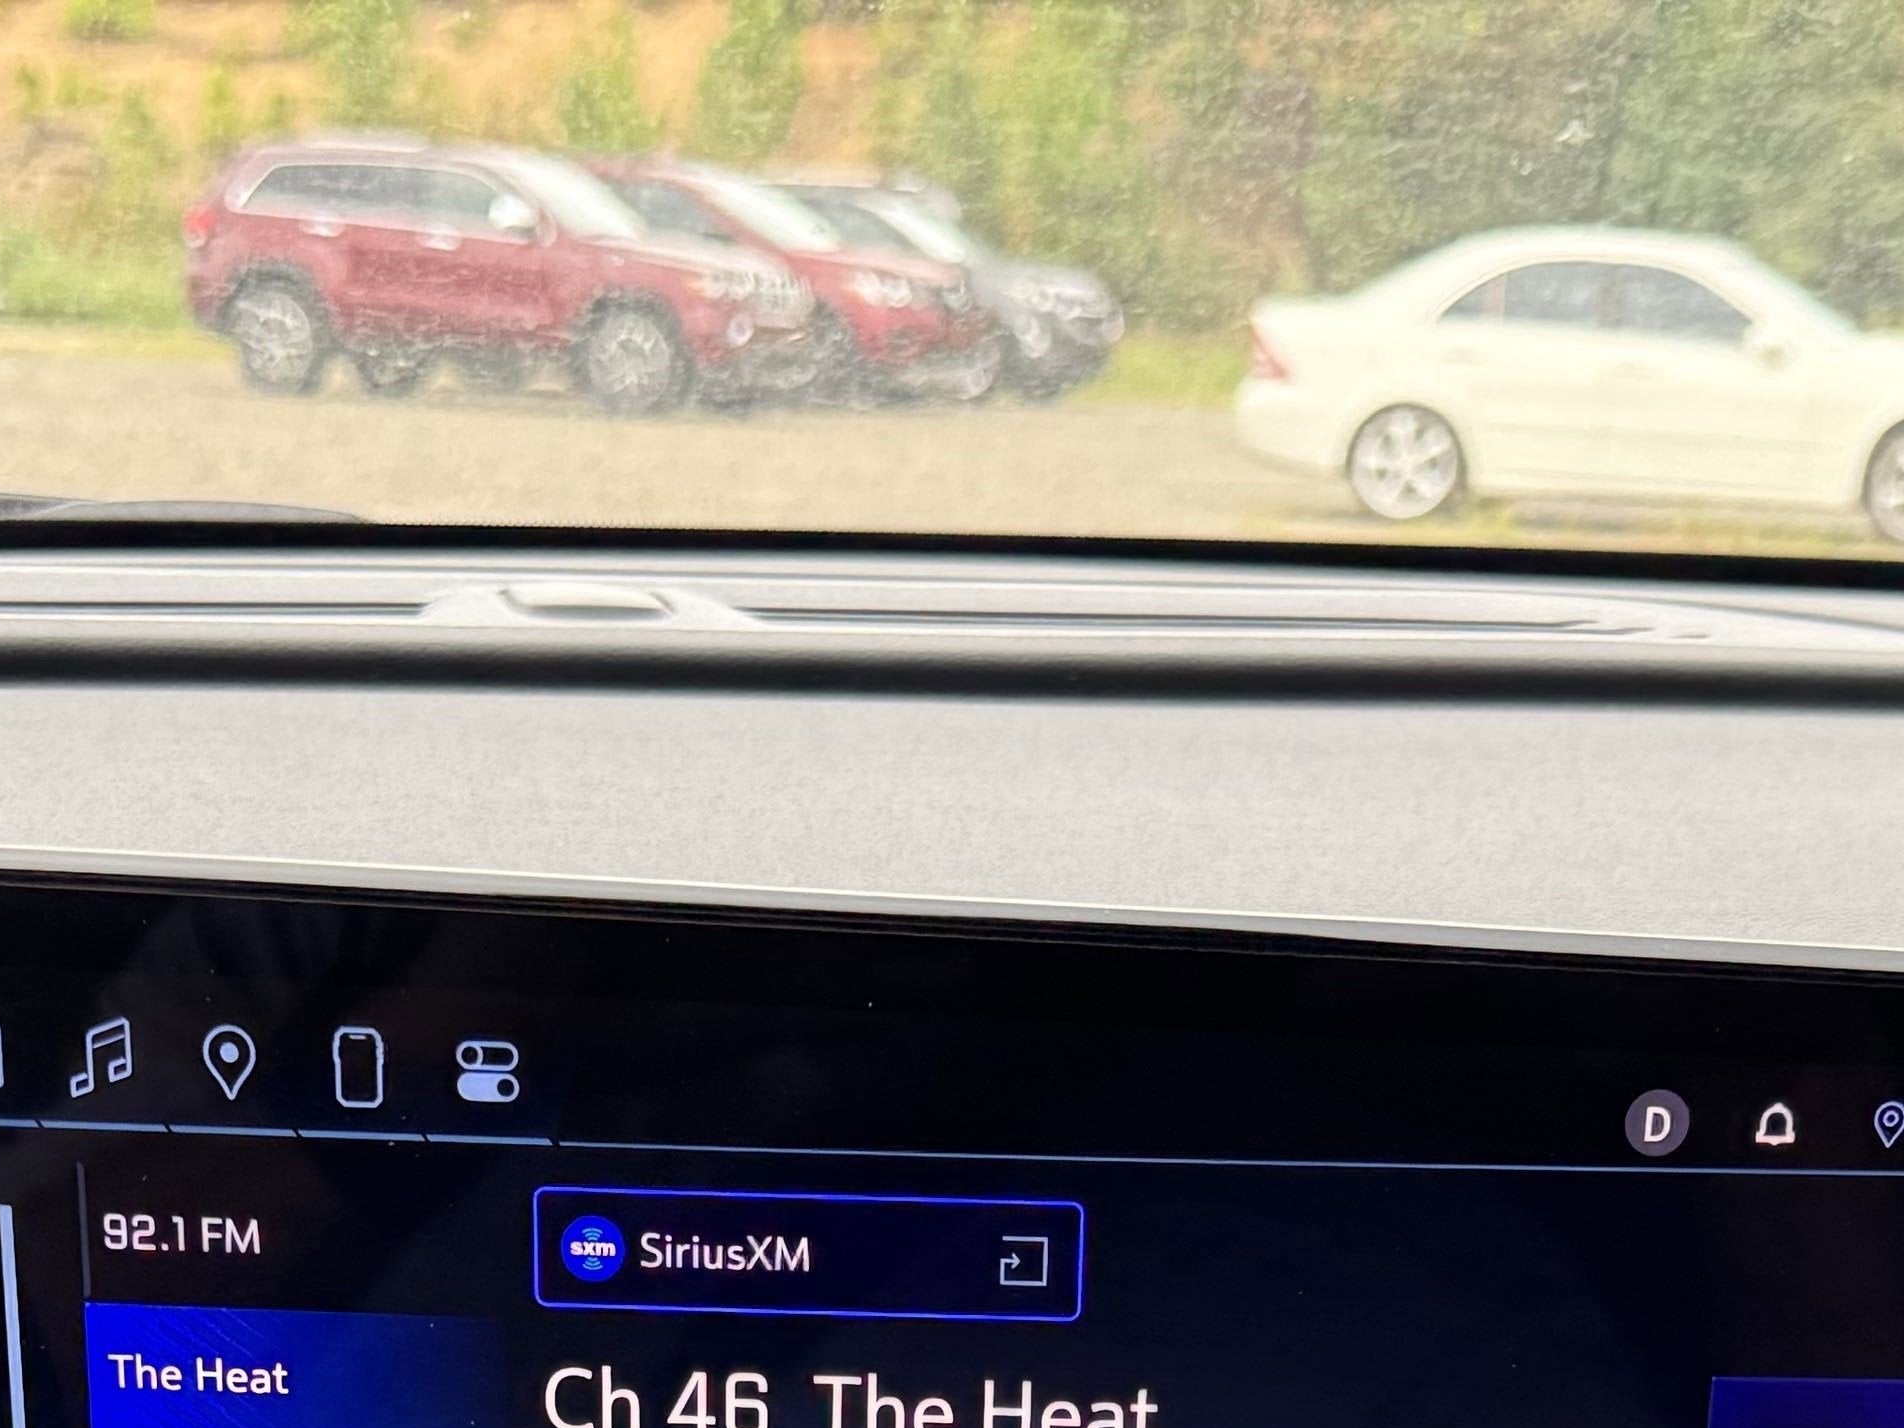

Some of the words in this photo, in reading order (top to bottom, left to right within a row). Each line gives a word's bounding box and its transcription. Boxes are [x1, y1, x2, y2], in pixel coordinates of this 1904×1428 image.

[1643, 1106, 1671, 1142] D
[103, 1212, 186, 1252] 92.1
[201, 1216, 261, 1255] FM
[569, 1241, 616, 1256] sxm
[640, 1232, 810, 1272] SiriusXM
[107, 1353, 183, 1391] The
[196, 1356, 289, 1395] Heat
